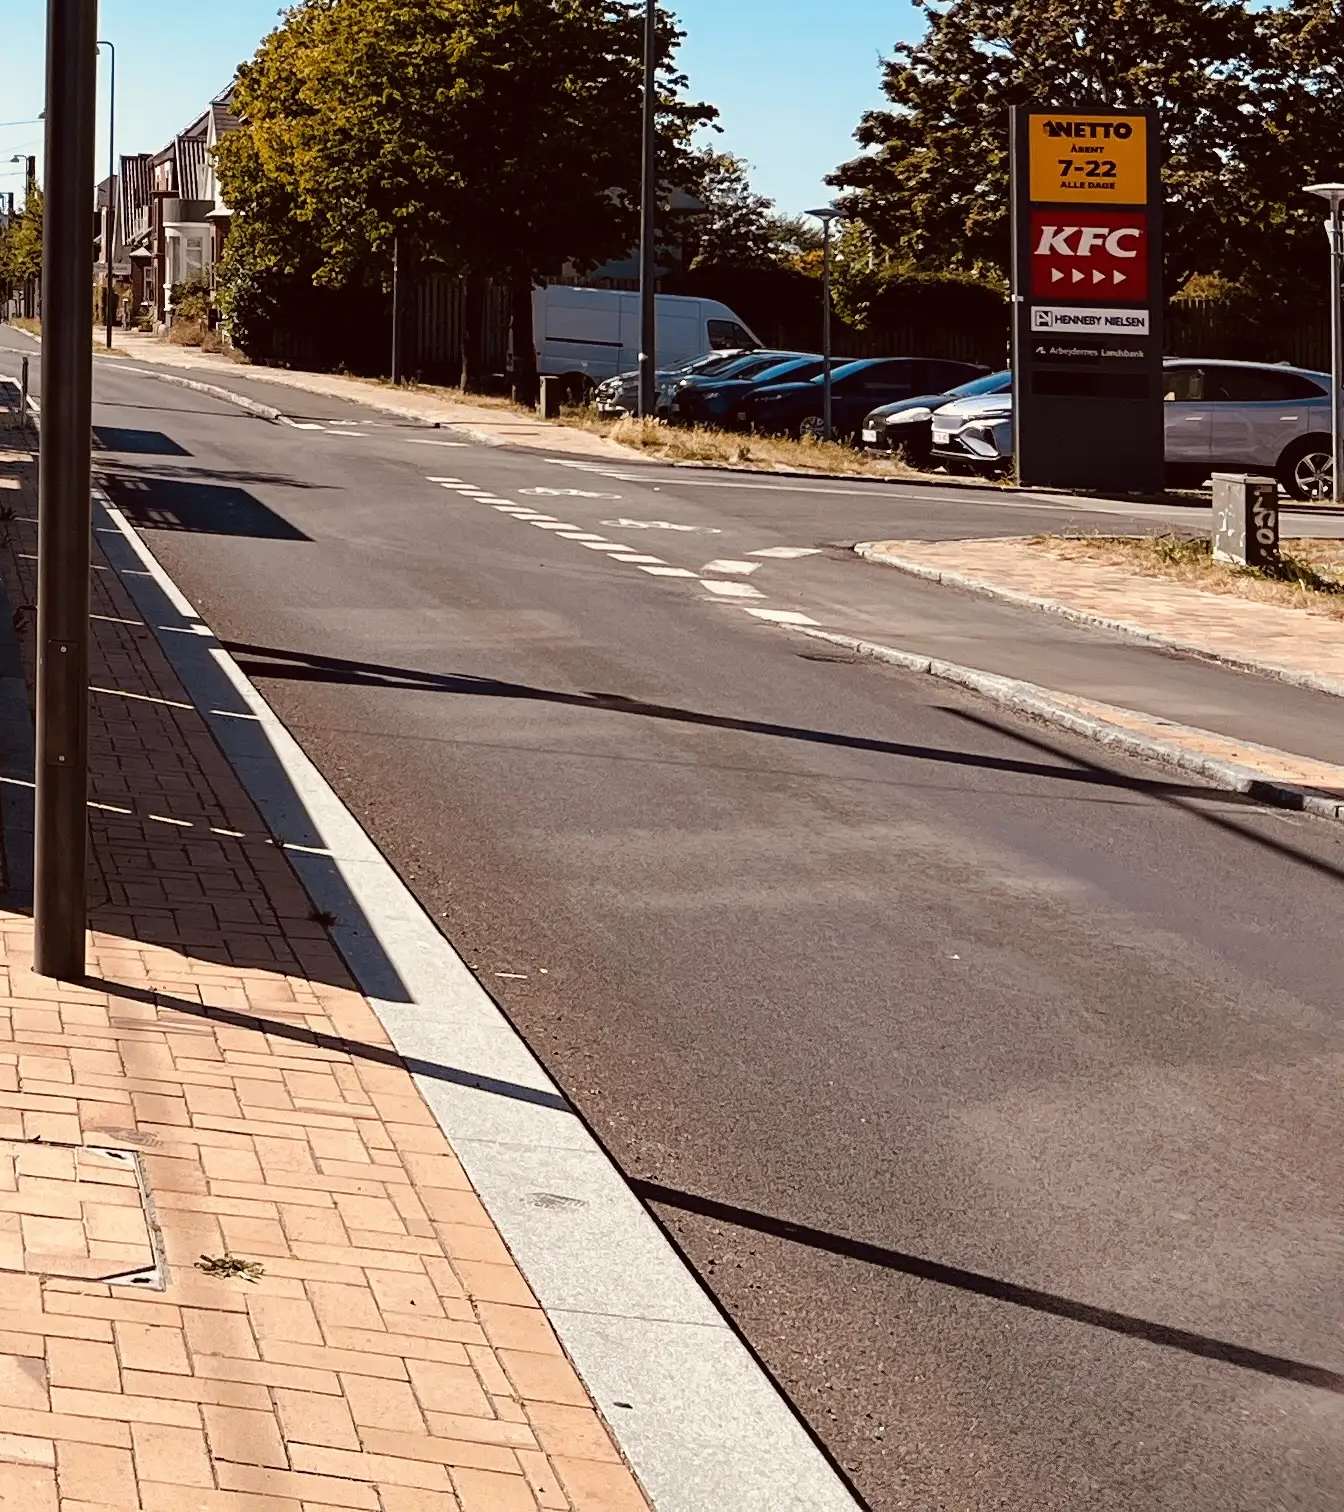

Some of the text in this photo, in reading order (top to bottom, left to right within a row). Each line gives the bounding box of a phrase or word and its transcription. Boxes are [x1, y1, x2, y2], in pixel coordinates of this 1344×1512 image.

[1050, 121, 1133, 140] NETTO
[1058, 159, 1117, 178] 7-22
[1060, 181, 1086, 189] ALLE
[1034, 225, 1141, 258] KFC
[1054, 315, 1145, 327] HENNEBY NIELSEN
